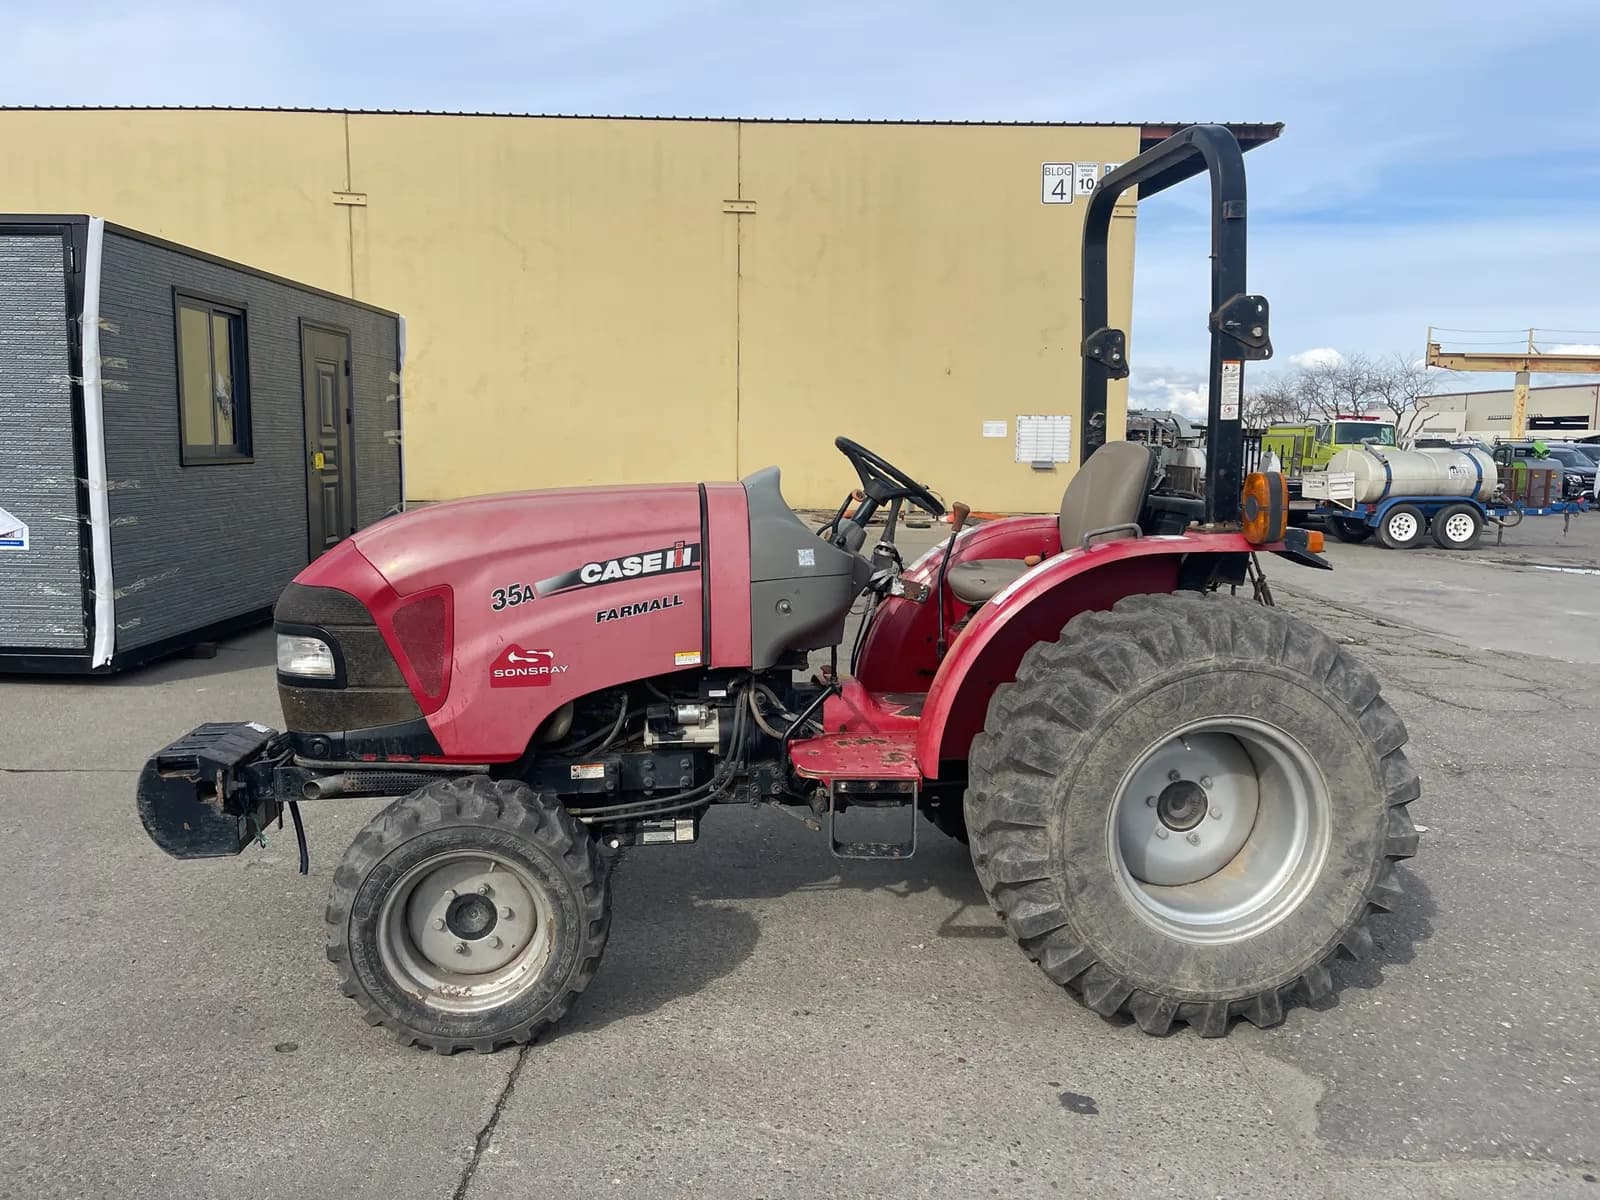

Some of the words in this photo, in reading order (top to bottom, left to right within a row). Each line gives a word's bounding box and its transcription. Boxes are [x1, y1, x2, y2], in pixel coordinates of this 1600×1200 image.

[1045, 167, 1071, 176] BLDG
[1052, 179, 1066, 200] 4
[1079, 178, 1094, 190] 10
[580, 552, 663, 584] CASE
[491, 583, 536, 611] 35A
[596, 594, 684, 623] FARMALL
[493, 665, 568, 678] SONSRAY
